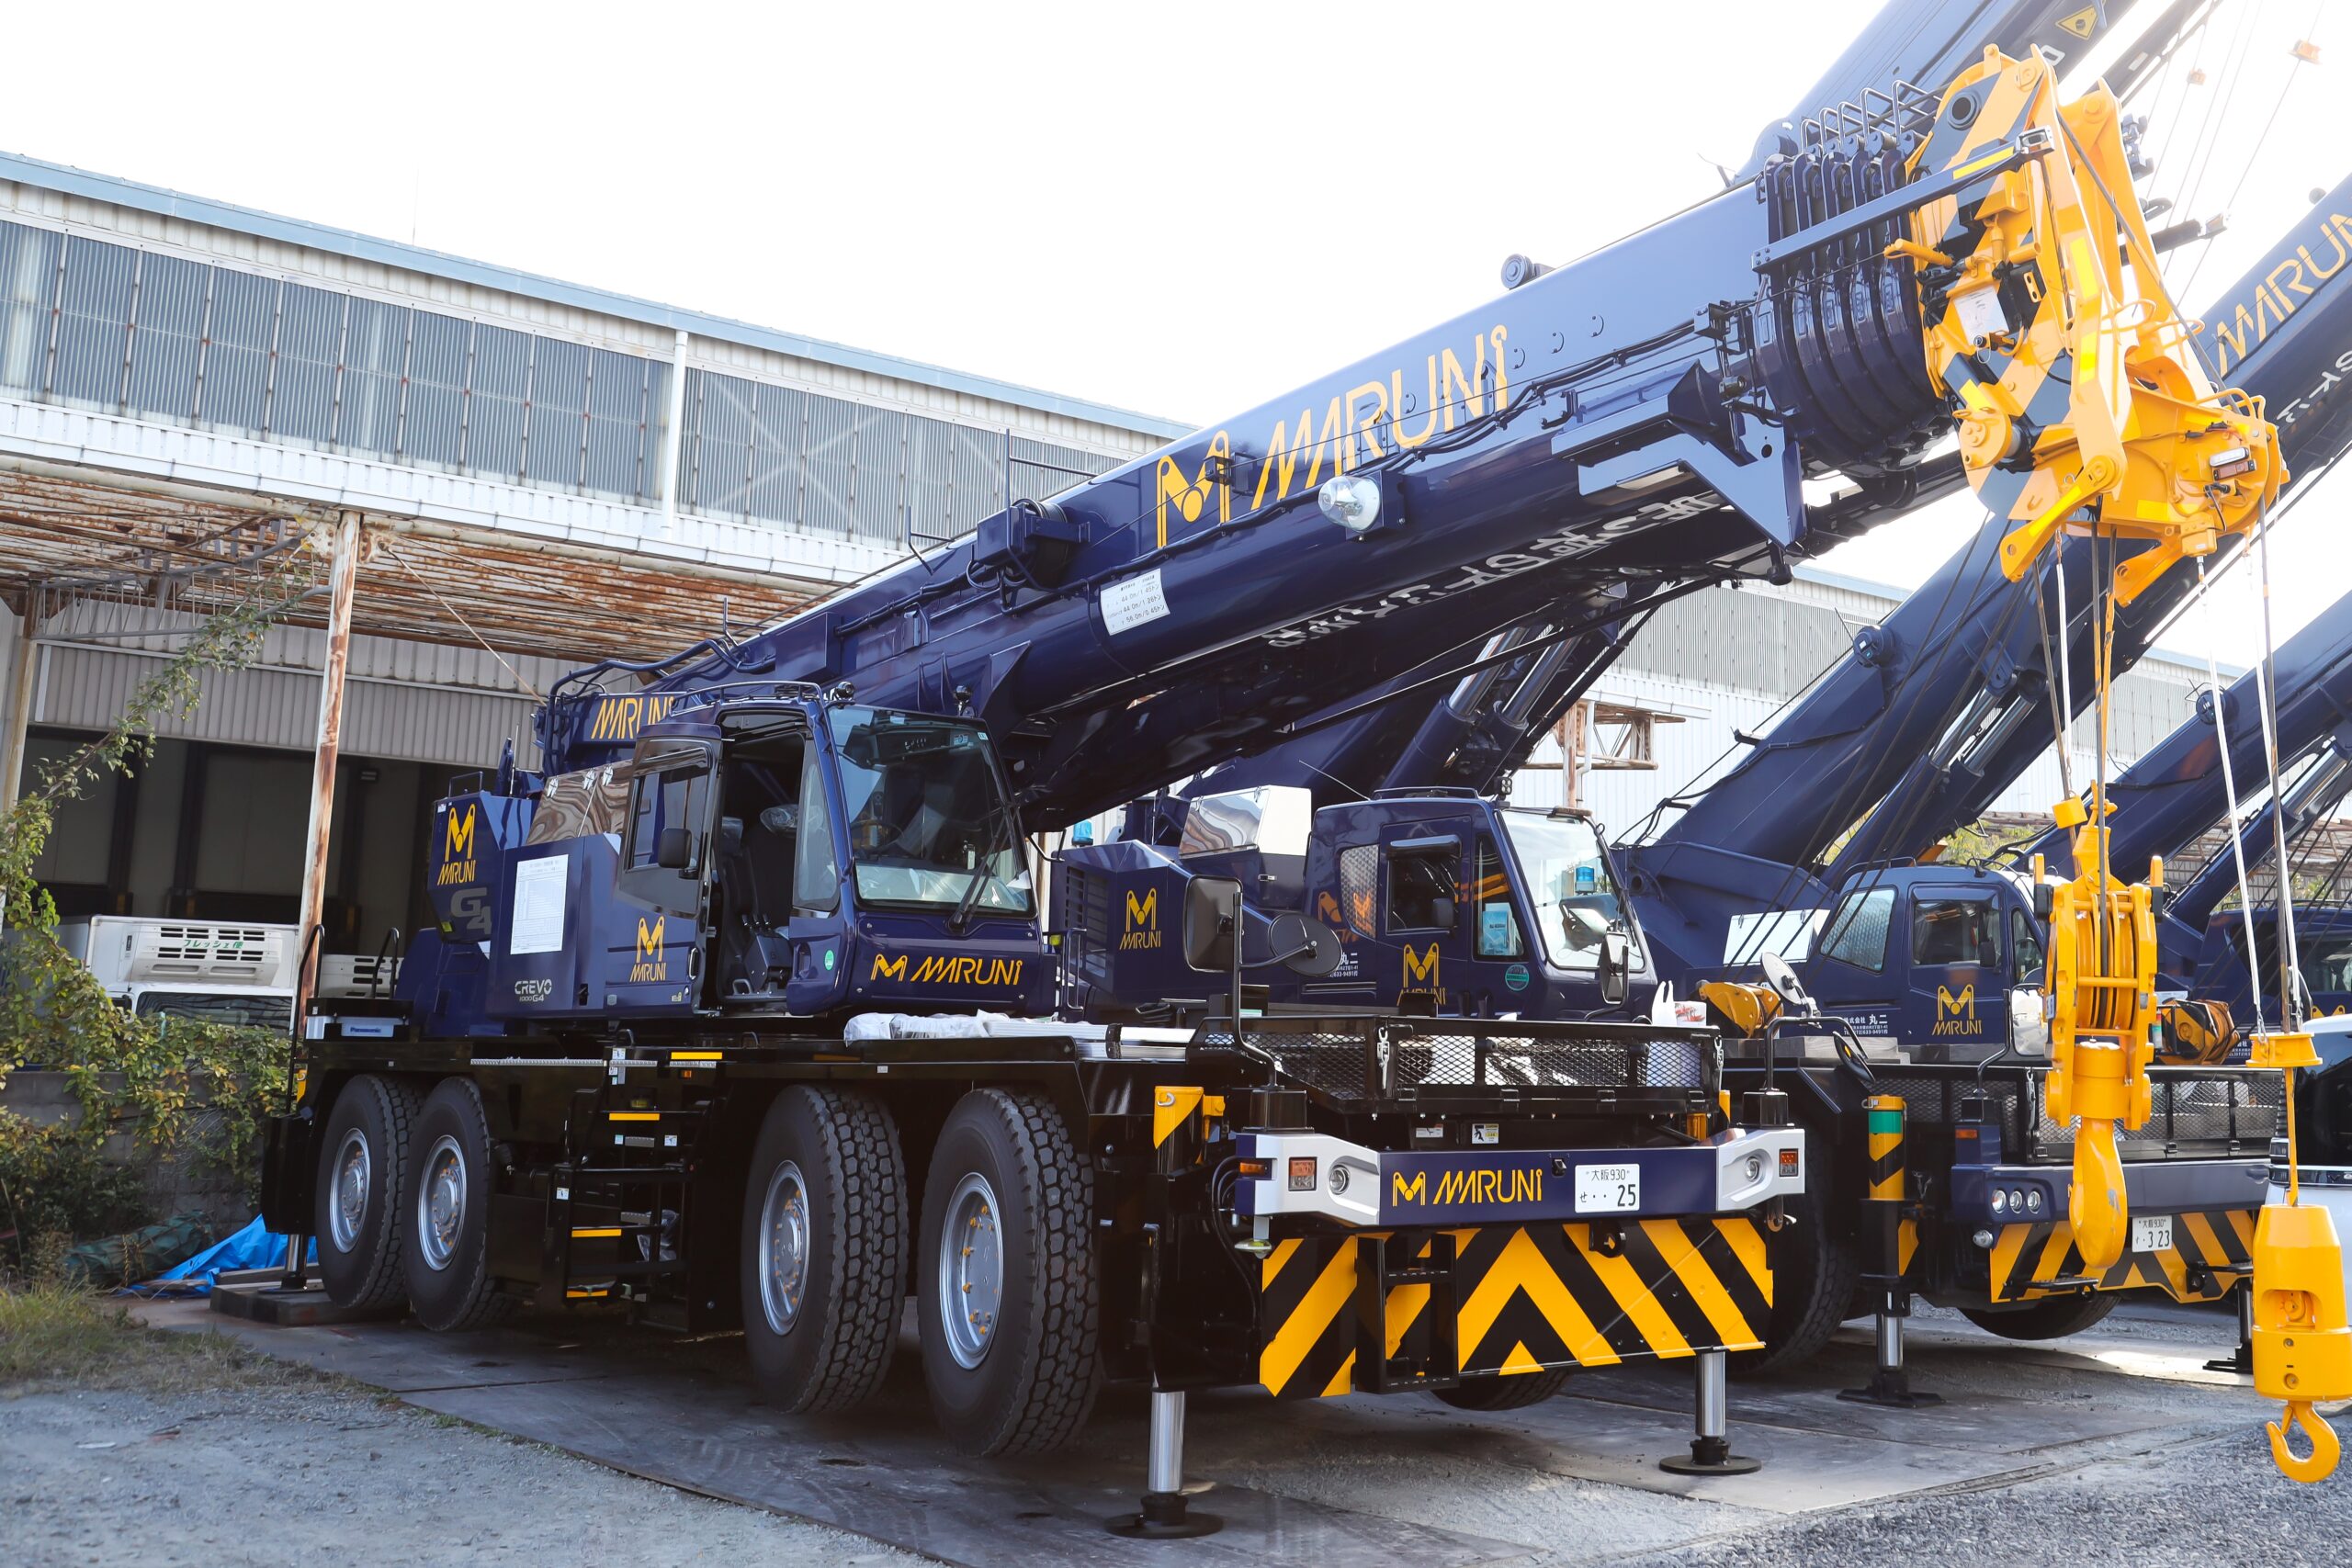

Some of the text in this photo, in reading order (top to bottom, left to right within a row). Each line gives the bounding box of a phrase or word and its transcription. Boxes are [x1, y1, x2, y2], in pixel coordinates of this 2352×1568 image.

[591, 695, 674, 739] MARUN
[436, 860, 476, 886] MARUNI
[451, 887, 492, 935] G4
[1119, 930, 1161, 951] MARUNI
[629, 963, 667, 983] MARUNI
[910, 956, 1023, 986] MARUNI
[514, 978, 553, 995] CREVO
[1869, 1014, 1888, 1025] 丸二
[1931, 1020, 1983, 1036] MARUNI
[1433, 1168, 1544, 1205] MARUNI
